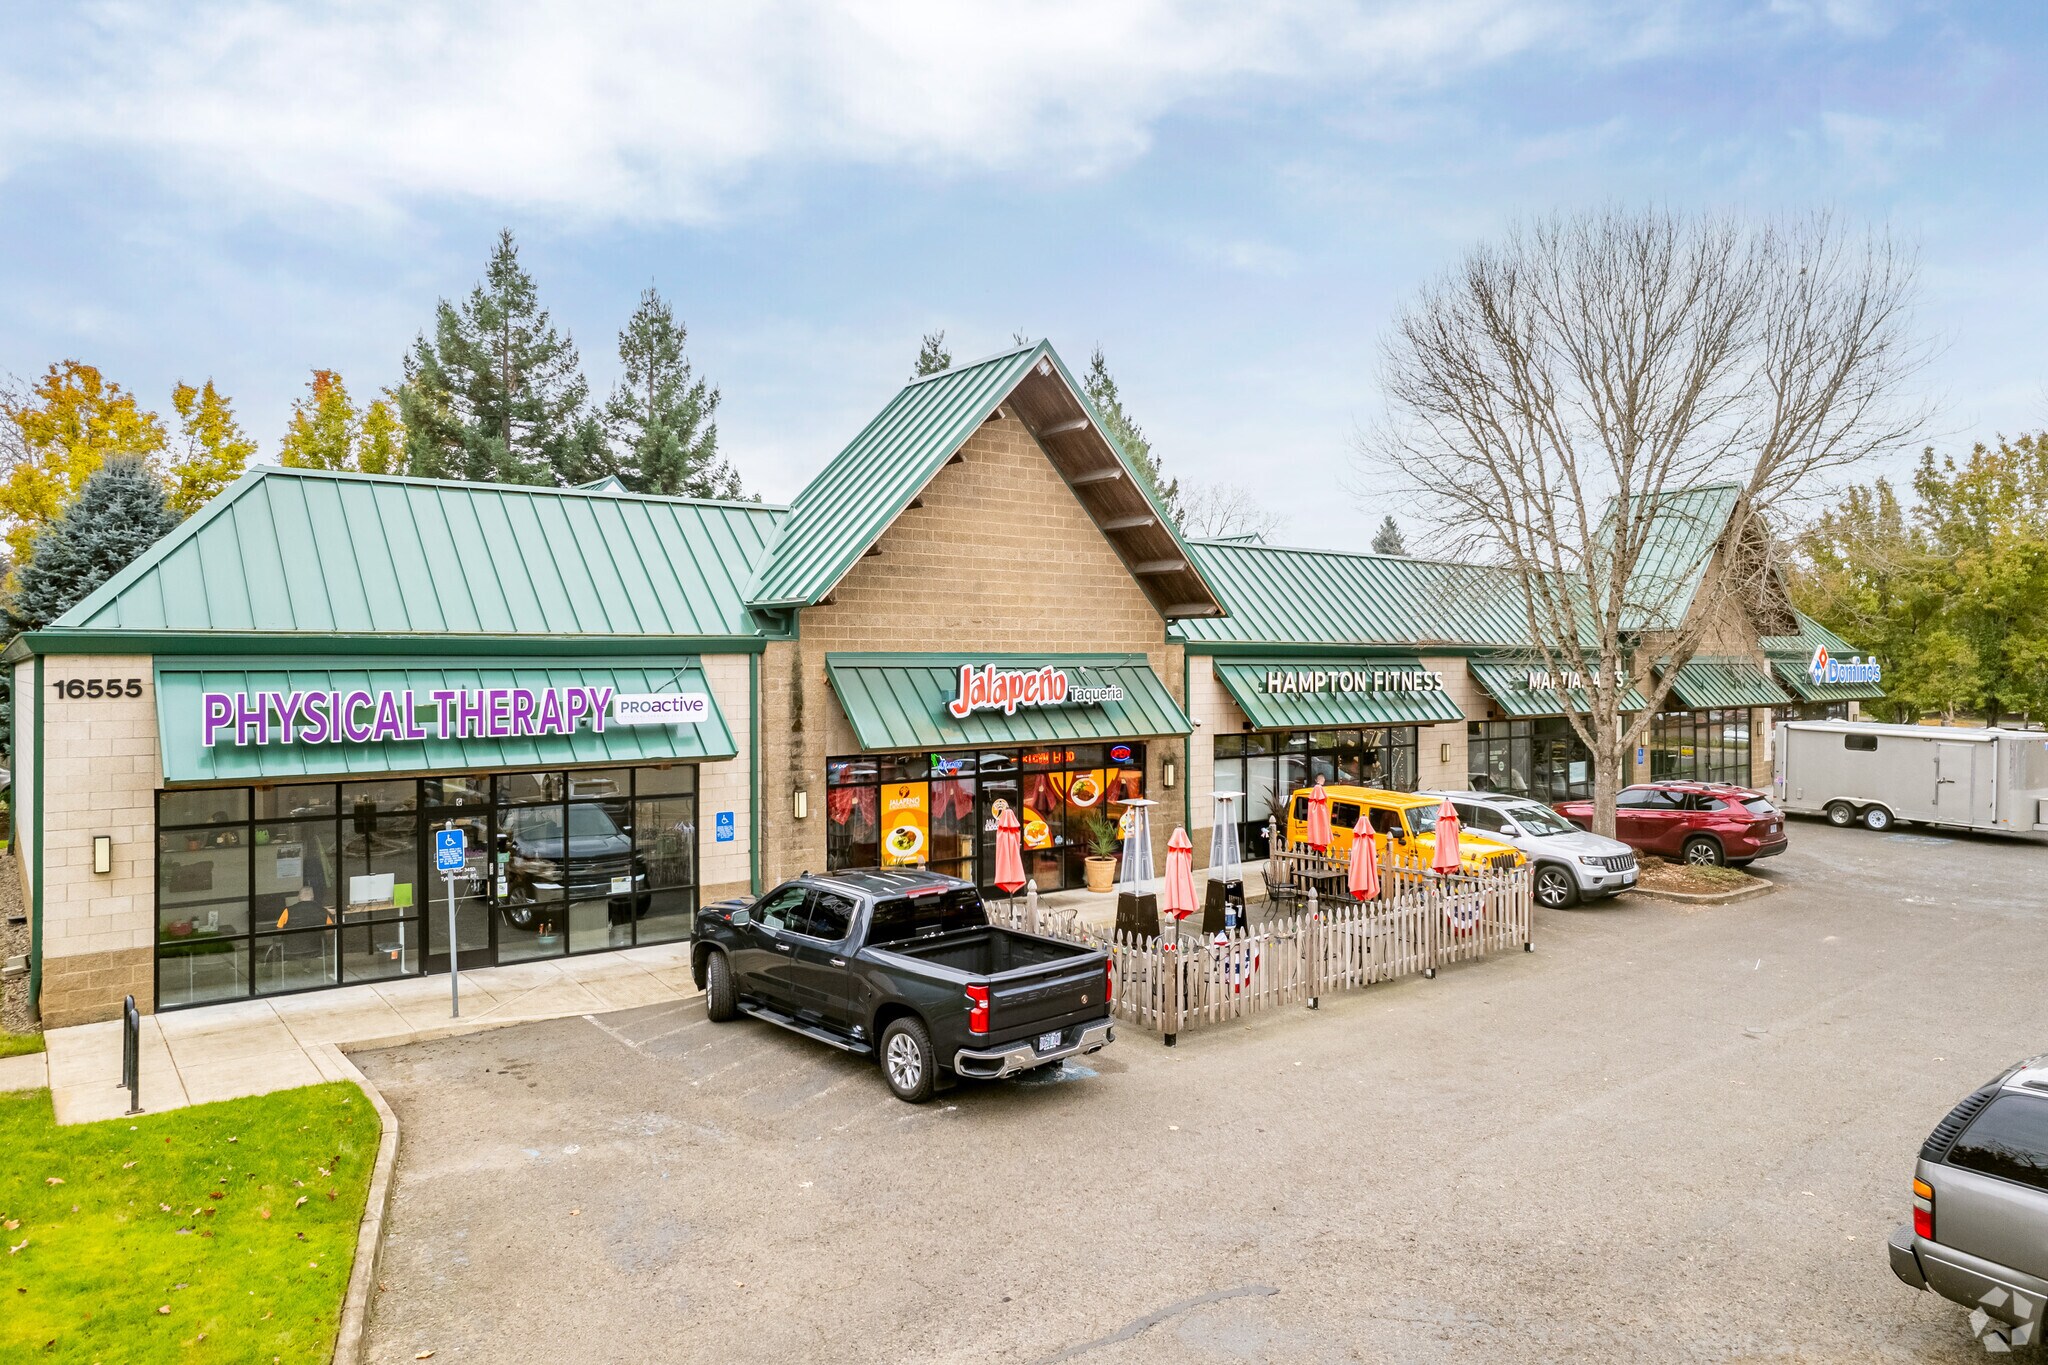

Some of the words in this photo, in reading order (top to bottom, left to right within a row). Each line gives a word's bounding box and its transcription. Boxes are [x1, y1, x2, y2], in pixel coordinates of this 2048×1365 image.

[1529, 671, 1586, 690] MATIA
[1592, 671, 1624, 688] AS
[1829, 656, 1881, 683] Domino's
[53, 679, 143, 699] 16555
[950, 663, 1068, 718] Jalapeño
[1069, 685, 1123, 704] Taqueria
[1267, 671, 1367, 693] HAMPTON
[1373, 671, 1444, 692] FITNESS
[620, 696, 704, 713] PROactive
[202, 690, 426, 747] PHYSICAL
[430, 686, 615, 740] THERAPY
